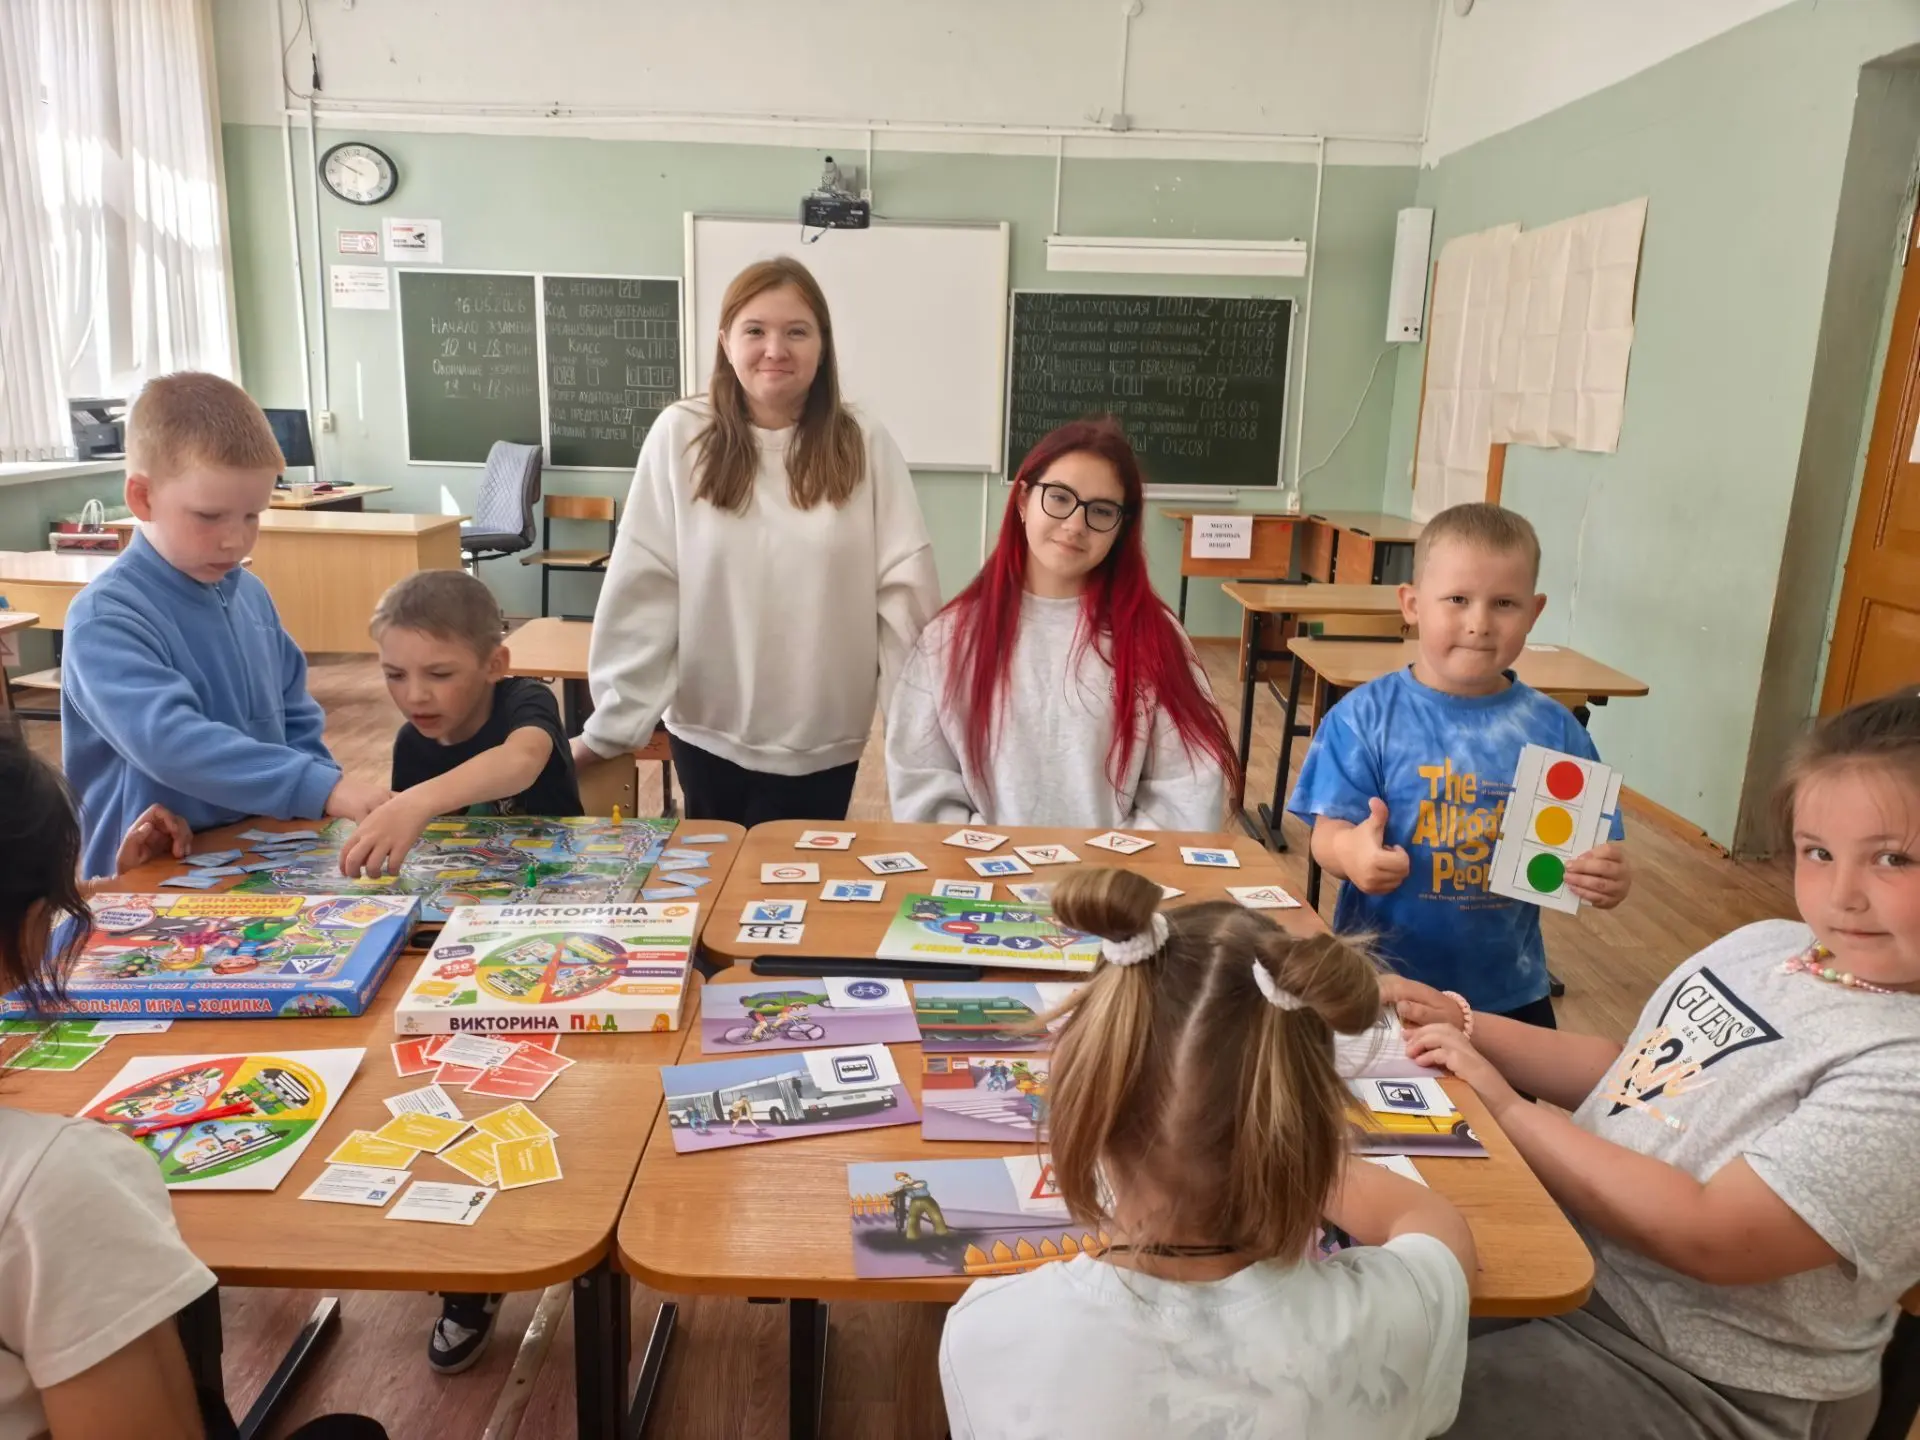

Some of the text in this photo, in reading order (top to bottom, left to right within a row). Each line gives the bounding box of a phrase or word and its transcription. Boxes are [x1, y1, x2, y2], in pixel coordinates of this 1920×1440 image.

[1210, 522, 1233, 530] МЕСТО
[1418, 756, 1478, 805] The
[1411, 799, 1506, 863] Alligat
[499, 906, 649, 918] ВИКТОРИНА
[146, 998, 184, 1013] ИГРА
[199, 998, 273, 1014] ХОДИЛКА
[450, 1014, 618, 1031] ВИКТОРИНА ПДД
[1676, 985, 1743, 1048] GUESS
